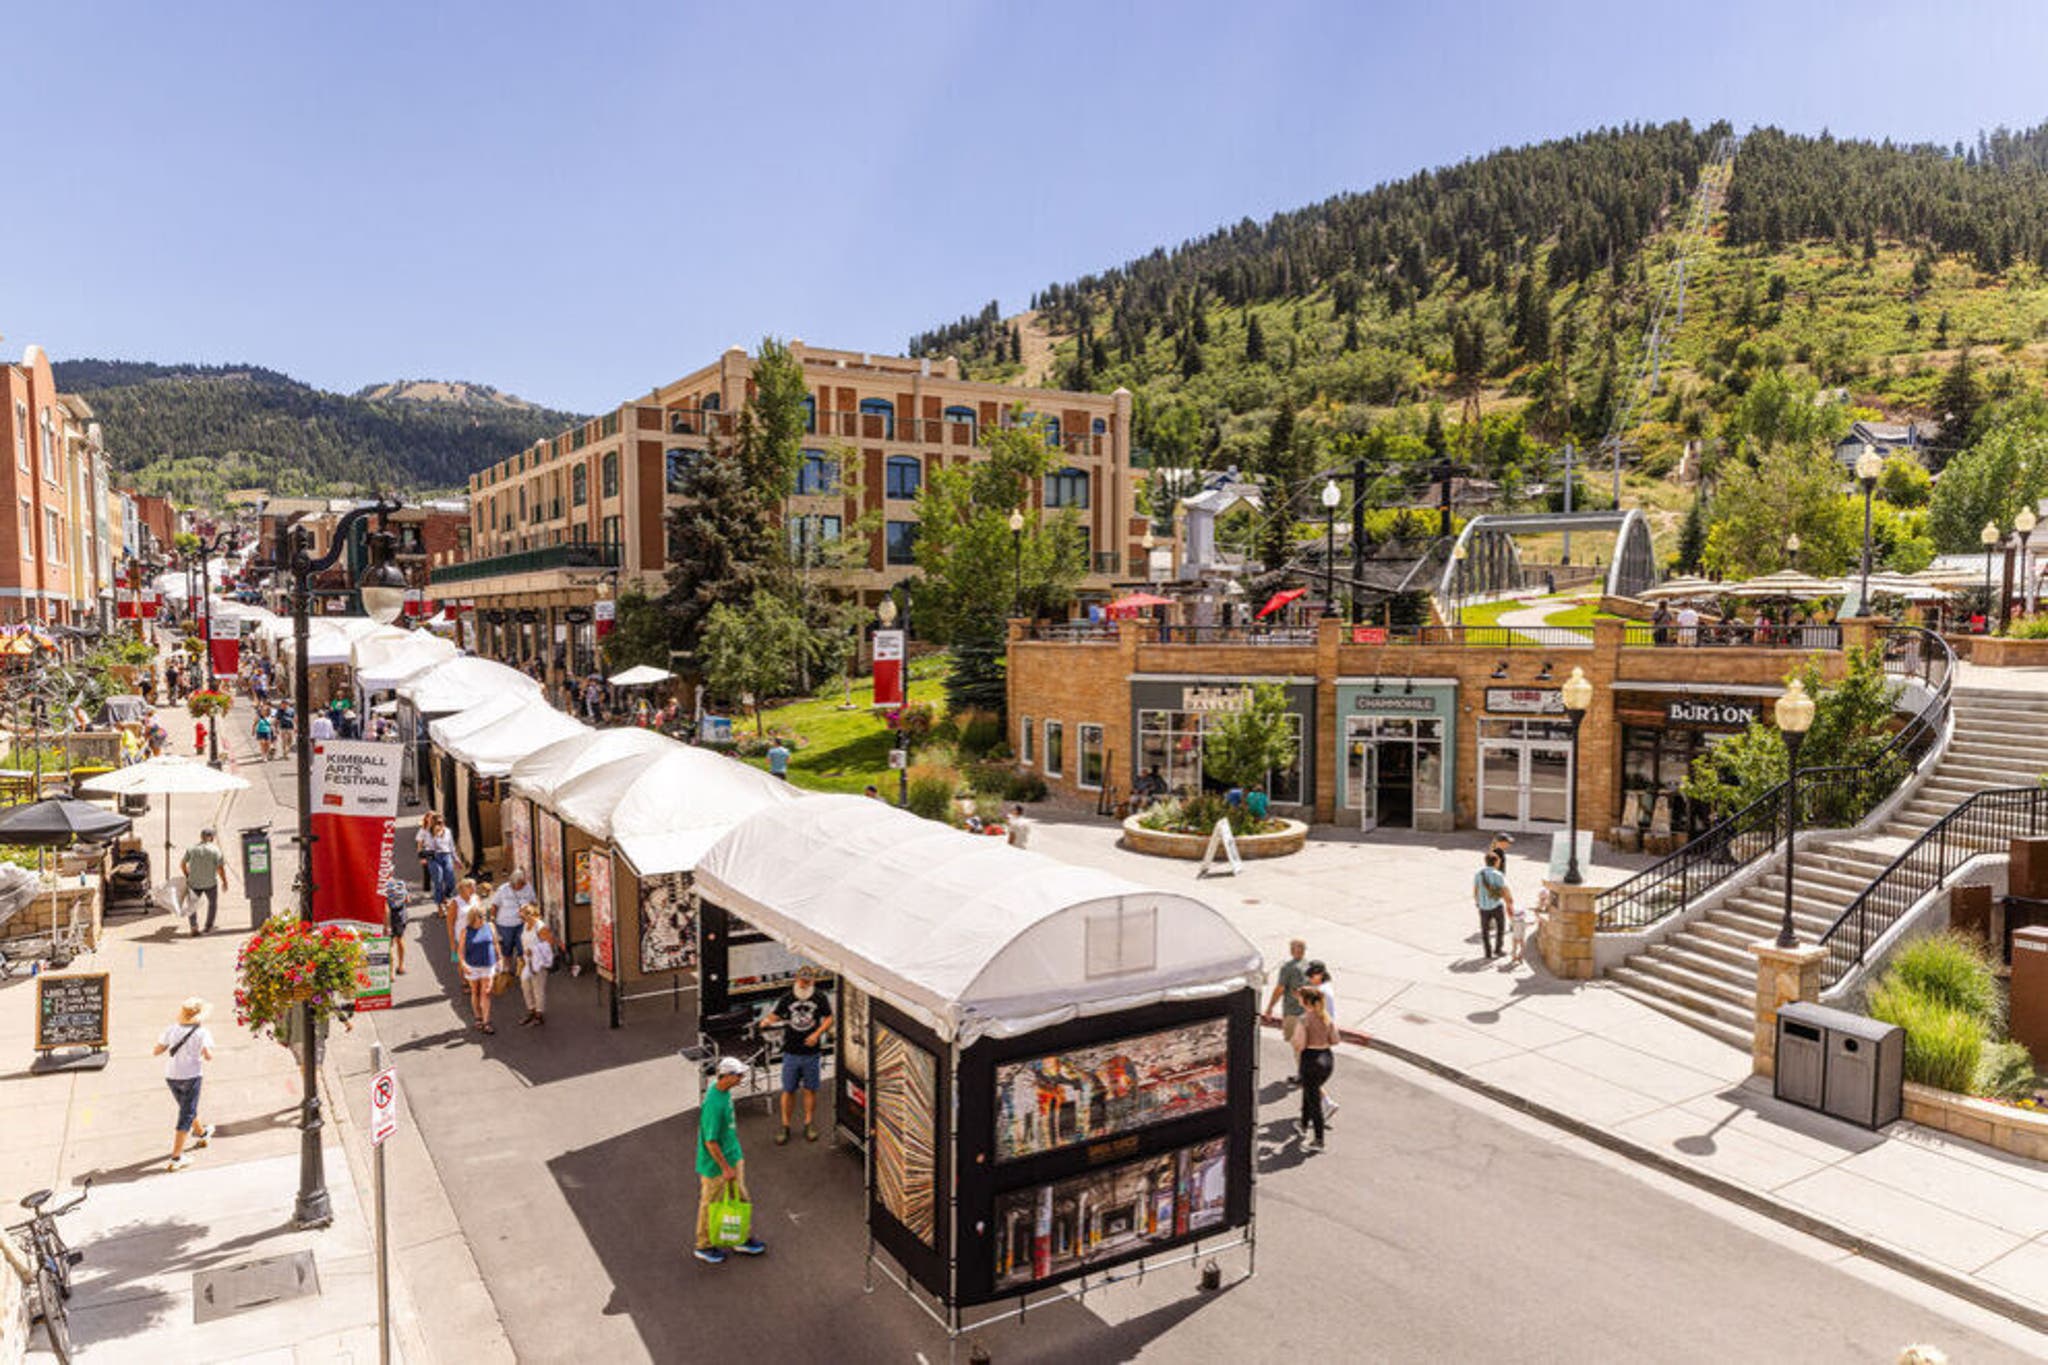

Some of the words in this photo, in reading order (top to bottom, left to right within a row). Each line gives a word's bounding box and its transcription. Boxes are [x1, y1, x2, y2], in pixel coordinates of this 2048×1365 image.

[1671, 702, 1753, 722] BURTON
[326, 754, 387, 766] KIMBALL
[325, 764, 363, 774] ARTS
[324, 773, 389, 786] FESTIVAL
[376, 841, 395, 897] AUGUST
